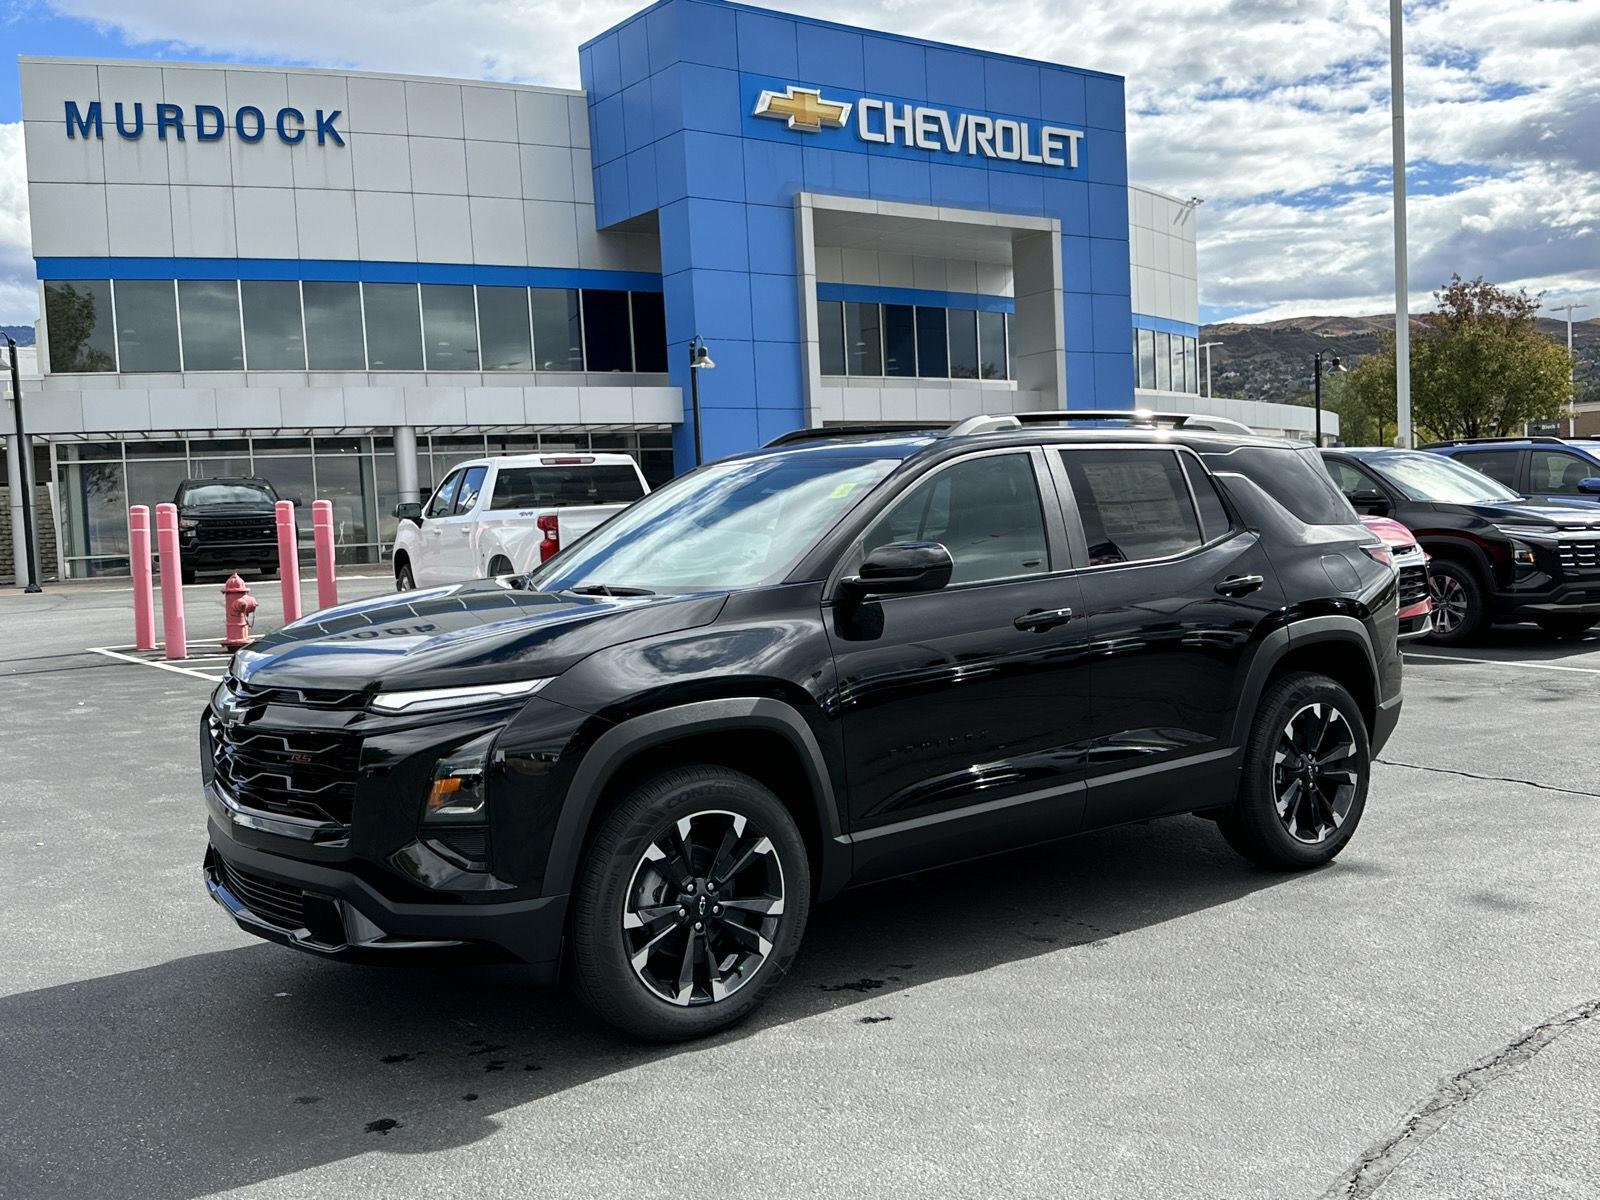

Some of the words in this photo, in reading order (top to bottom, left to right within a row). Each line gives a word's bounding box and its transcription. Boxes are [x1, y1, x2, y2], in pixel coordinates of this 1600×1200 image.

[64, 100, 346, 148] MURDOCK
[857, 97, 1084, 168] CHEVROLET
[291, 752, 312, 764] RS
